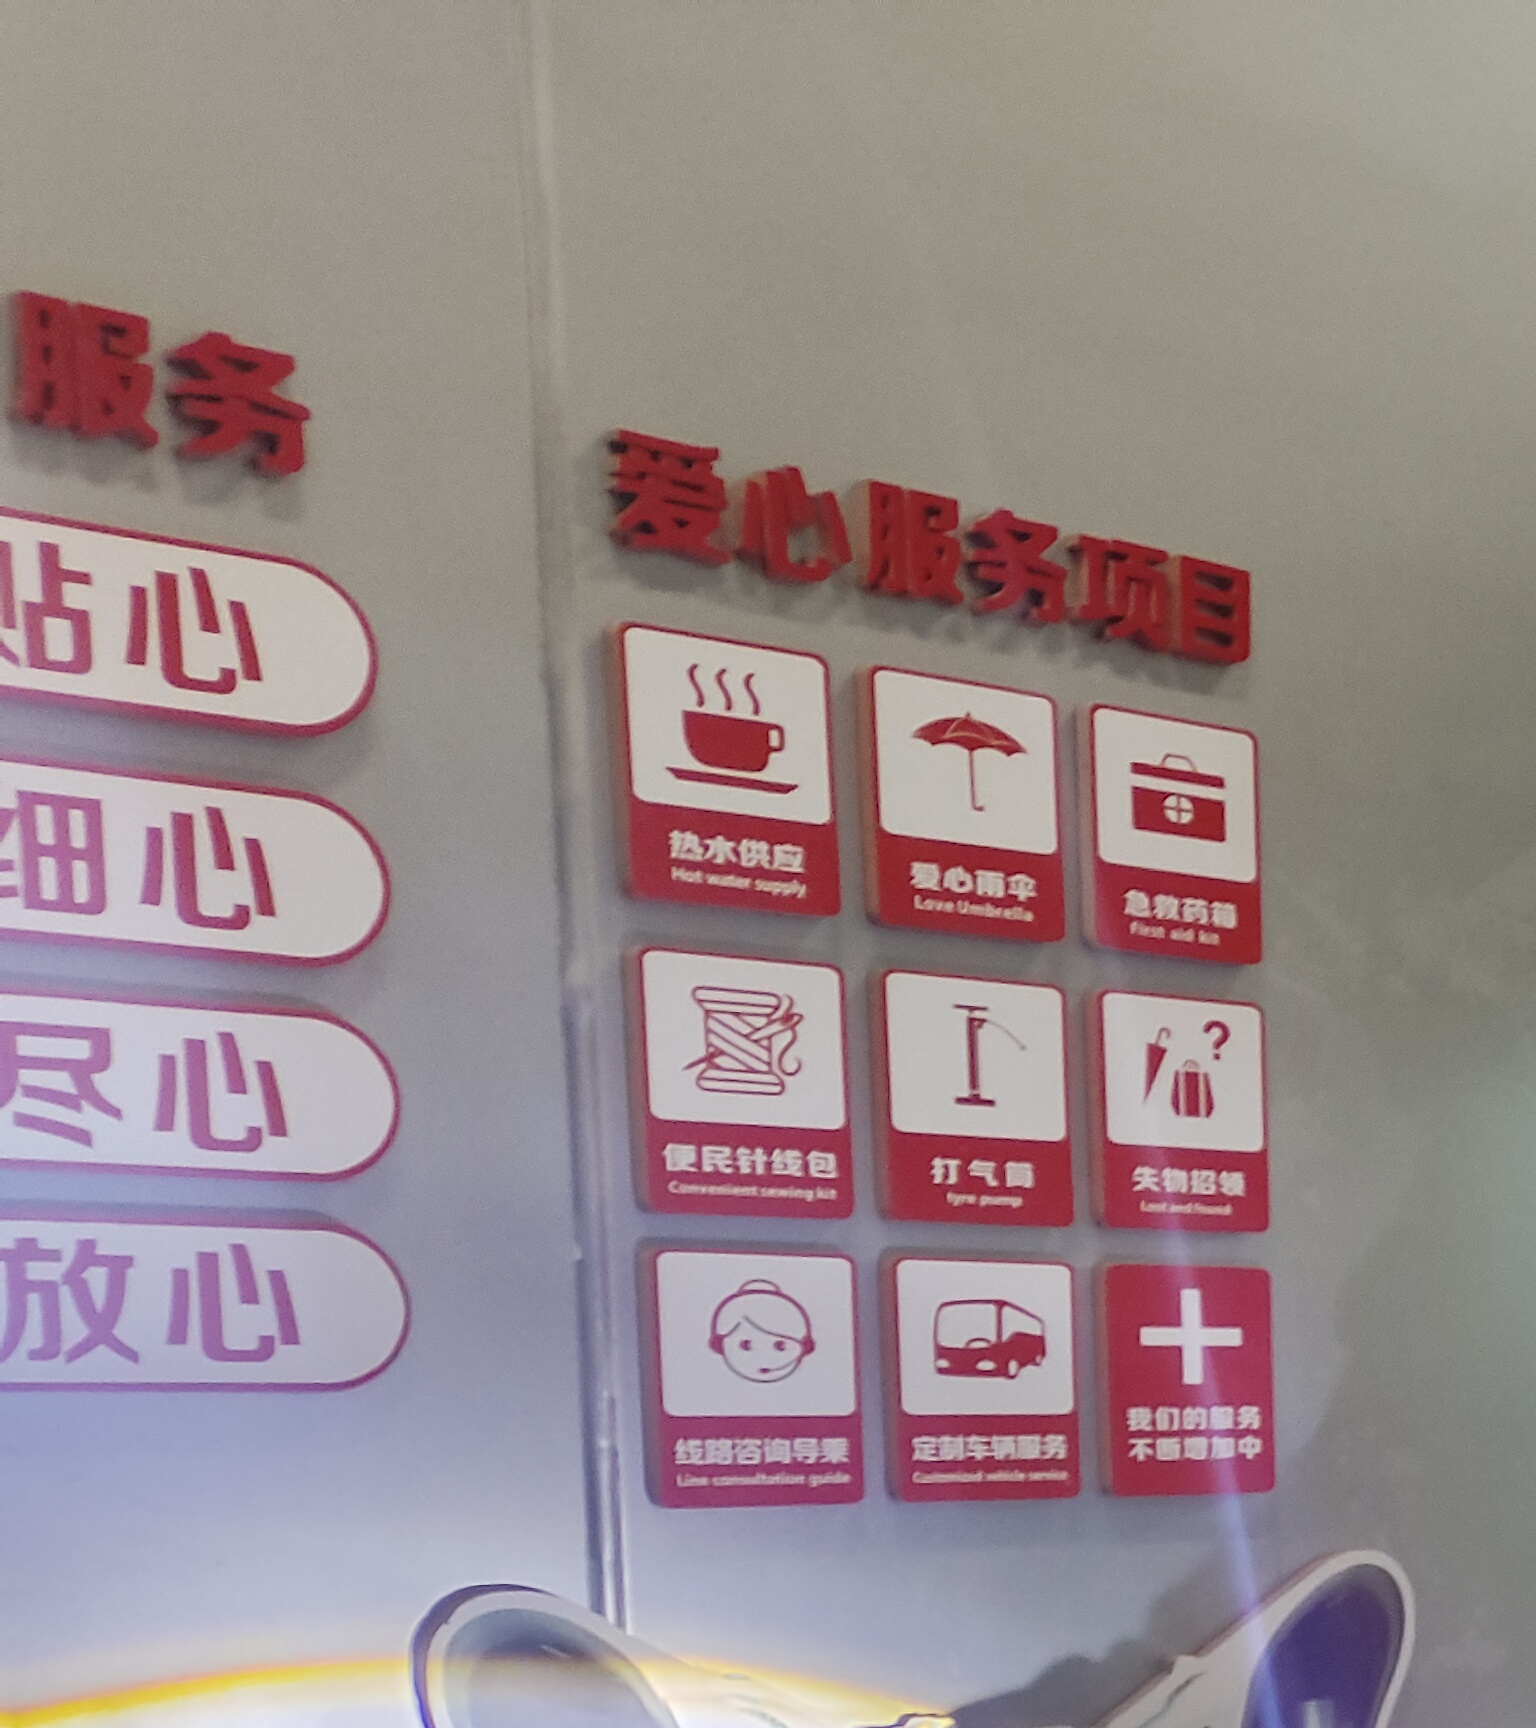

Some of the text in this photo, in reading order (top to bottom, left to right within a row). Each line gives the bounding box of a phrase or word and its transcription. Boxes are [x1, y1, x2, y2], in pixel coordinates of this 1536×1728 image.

[12, 289, 311, 474] 服务
[608, 429, 1251, 663] 爱心服务项目
[0, 540, 263, 695] 贴心
[0, 790, 277, 931] 细心
[668, 829, 805, 874] 热水供应
[670, 865, 807, 899] Hot water supply
[910, 861, 1038, 902] 爱心雨伞
[913, 894, 956, 913] Love
[1123, 888, 1238, 930] 急救药箱
[1129, 920, 1166, 939] First
[1169, 926, 1195, 943] aid
[0, 1021, 288, 1153] 尽心
[662, 1142, 840, 1179] 便民针线包
[930, 1156, 1035, 1189] 打气筒
[1131, 1165, 1246, 1197] 失物招领
[0, 1237, 301, 1365] 放心
[1126, 1406, 1261, 1431] 我们的服务
[674, 1437, 850, 1464] 线路咨询导乘
[911, 1434, 1068, 1461] 定制车辆服务
